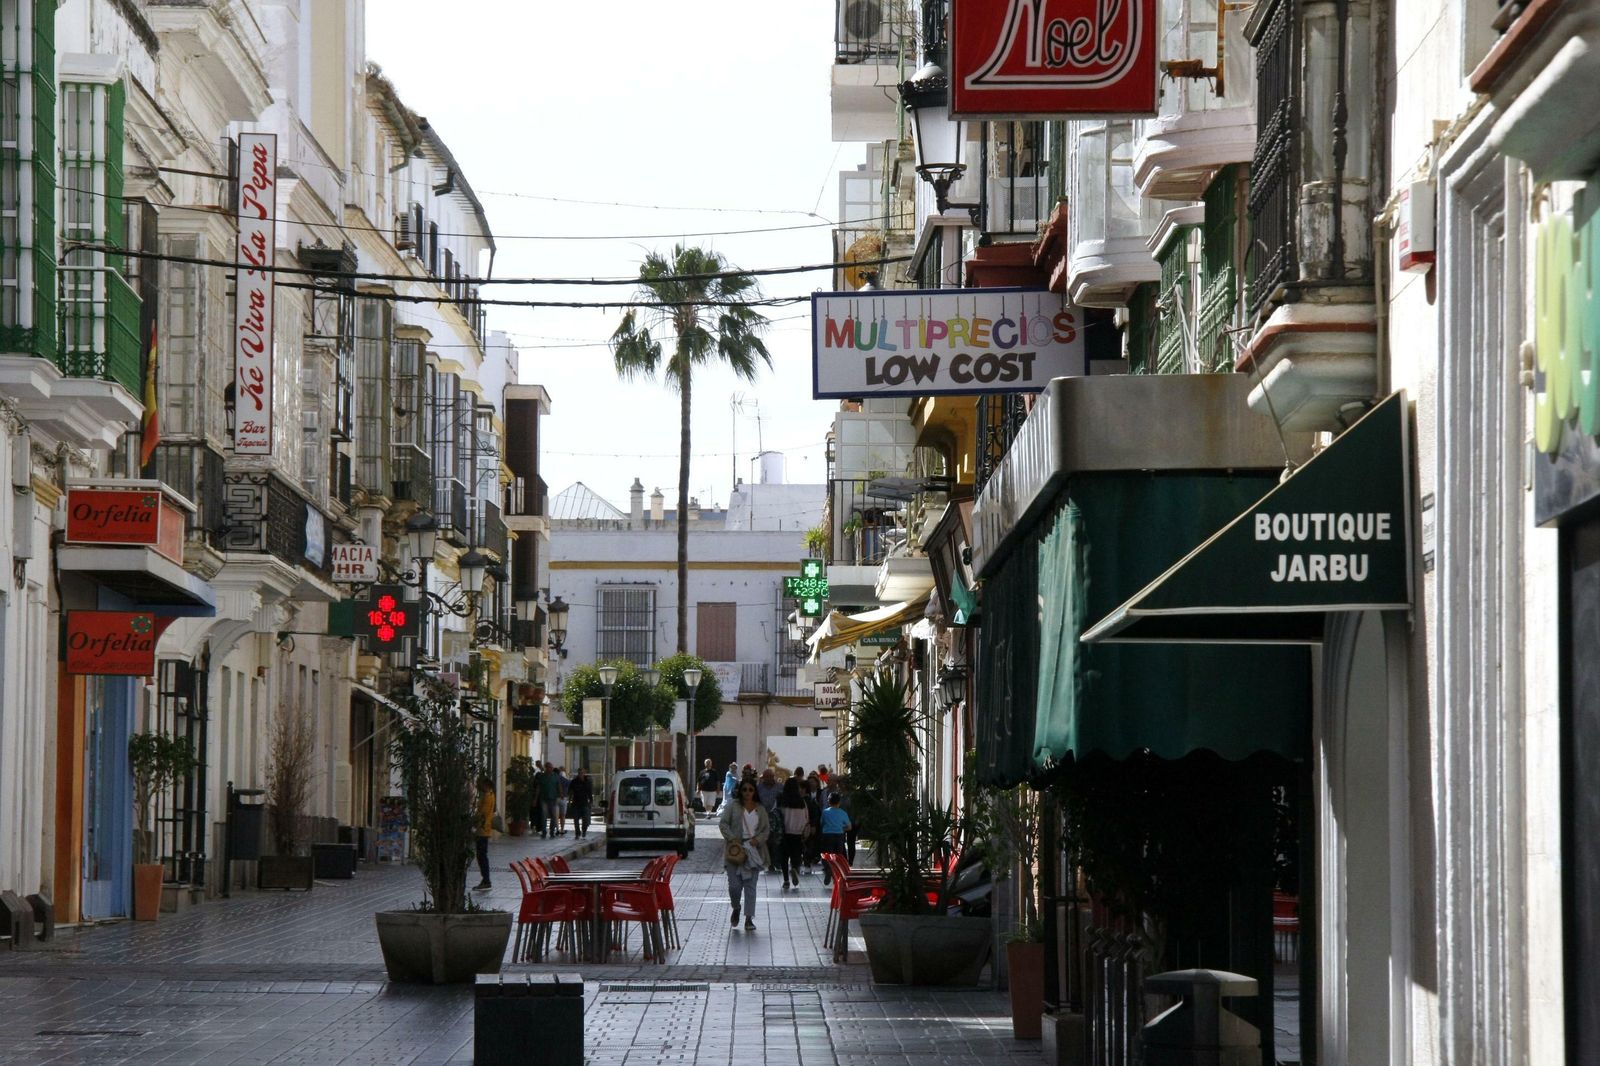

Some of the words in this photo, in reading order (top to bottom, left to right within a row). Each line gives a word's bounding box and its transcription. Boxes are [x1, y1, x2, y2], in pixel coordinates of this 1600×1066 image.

[243, 142, 275, 220] Pepa
[241, 230, 267, 279] La
[240, 287, 265, 358] Viva
[825, 312, 1077, 351] MULTIPRECIOS
[865, 352, 940, 385] LOW
[949, 352, 1037, 384] COST
[240, 364, 265, 411] Ke
[240, 420, 266, 434] Bar
[73, 503, 152, 528] Orfelia
[1255, 512, 1392, 542] BOUTIQUE
[1270, 554, 1369, 582] JARBU
[368, 611, 405, 626] 16:48
[69, 632, 152, 657] Orfelia
[816, 697, 824, 705] LA
